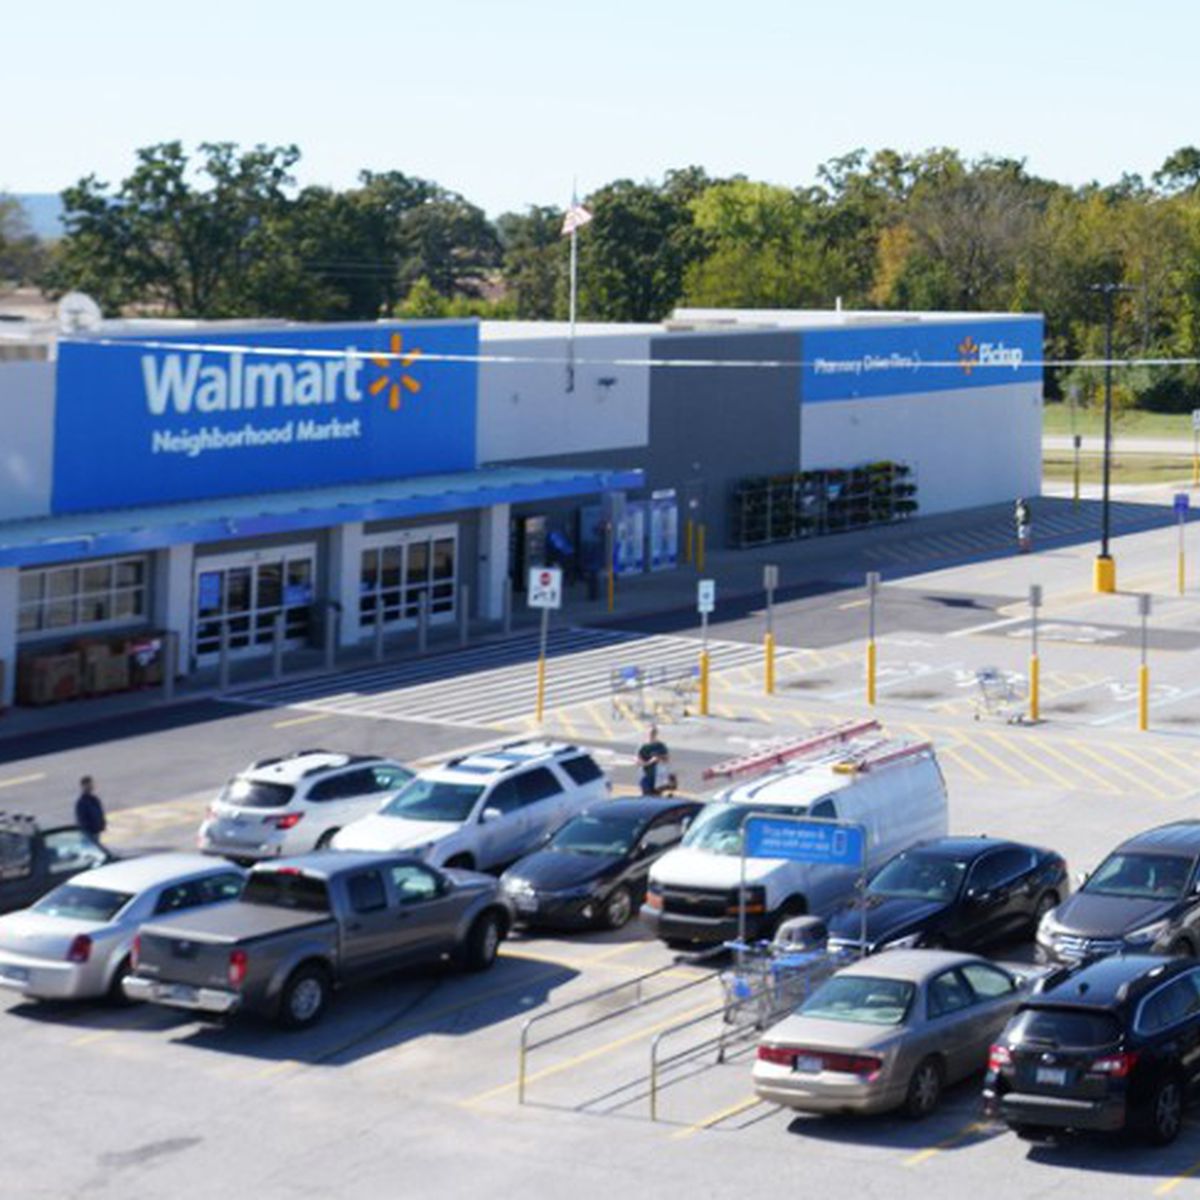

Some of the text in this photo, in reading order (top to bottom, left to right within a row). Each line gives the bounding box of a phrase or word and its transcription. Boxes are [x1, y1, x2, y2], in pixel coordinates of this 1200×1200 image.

[979, 342, 1023, 371] Pickup
[141, 346, 364, 415] Walmart
[152, 417, 361, 457] Neighborhood Market
